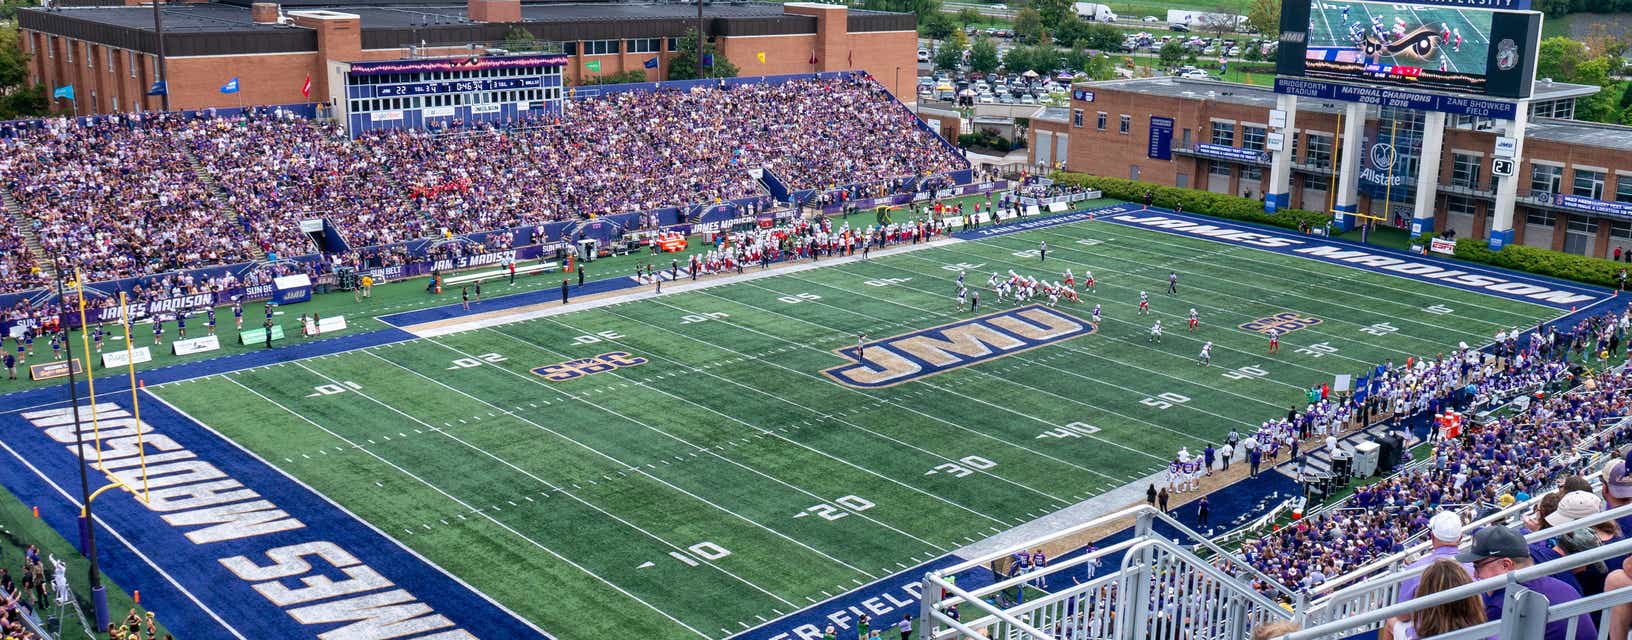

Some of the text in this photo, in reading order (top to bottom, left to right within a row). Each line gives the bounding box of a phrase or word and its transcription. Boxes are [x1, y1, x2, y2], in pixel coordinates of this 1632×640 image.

[396, 86, 407, 95] 22
[1279, 79, 1327, 90] BRIDGEFORTH
[1286, 86, 1318, 96] STADIUM
[1341, 86, 1432, 103] NATIONAL CHAMPIONS
[1360, 95, 1409, 108] 2004 2016
[1447, 97, 1511, 112] ZANE SHOWKER
[1466, 106, 1489, 116] FIELD
[1495, 161, 1511, 173] 21
[1360, 168, 1401, 186] Allstate
[691, 221, 720, 234] JAMES
[1113, 215, 1597, 304] JAMES MADISON
[246, 285, 263, 295] SUN
[150, 293, 213, 313] MADISON
[17, 319, 36, 328] SUN
[830, 304, 1091, 387] JMU
[1138, 391, 1192, 410] 50
[1044, 421, 1102, 439] 40
[933, 455, 998, 479] 30
[807, 494, 876, 521] 20
[669, 541, 732, 567] 10
[217, 541, 481, 640] MES
[826, 581, 923, 631] FIELD
